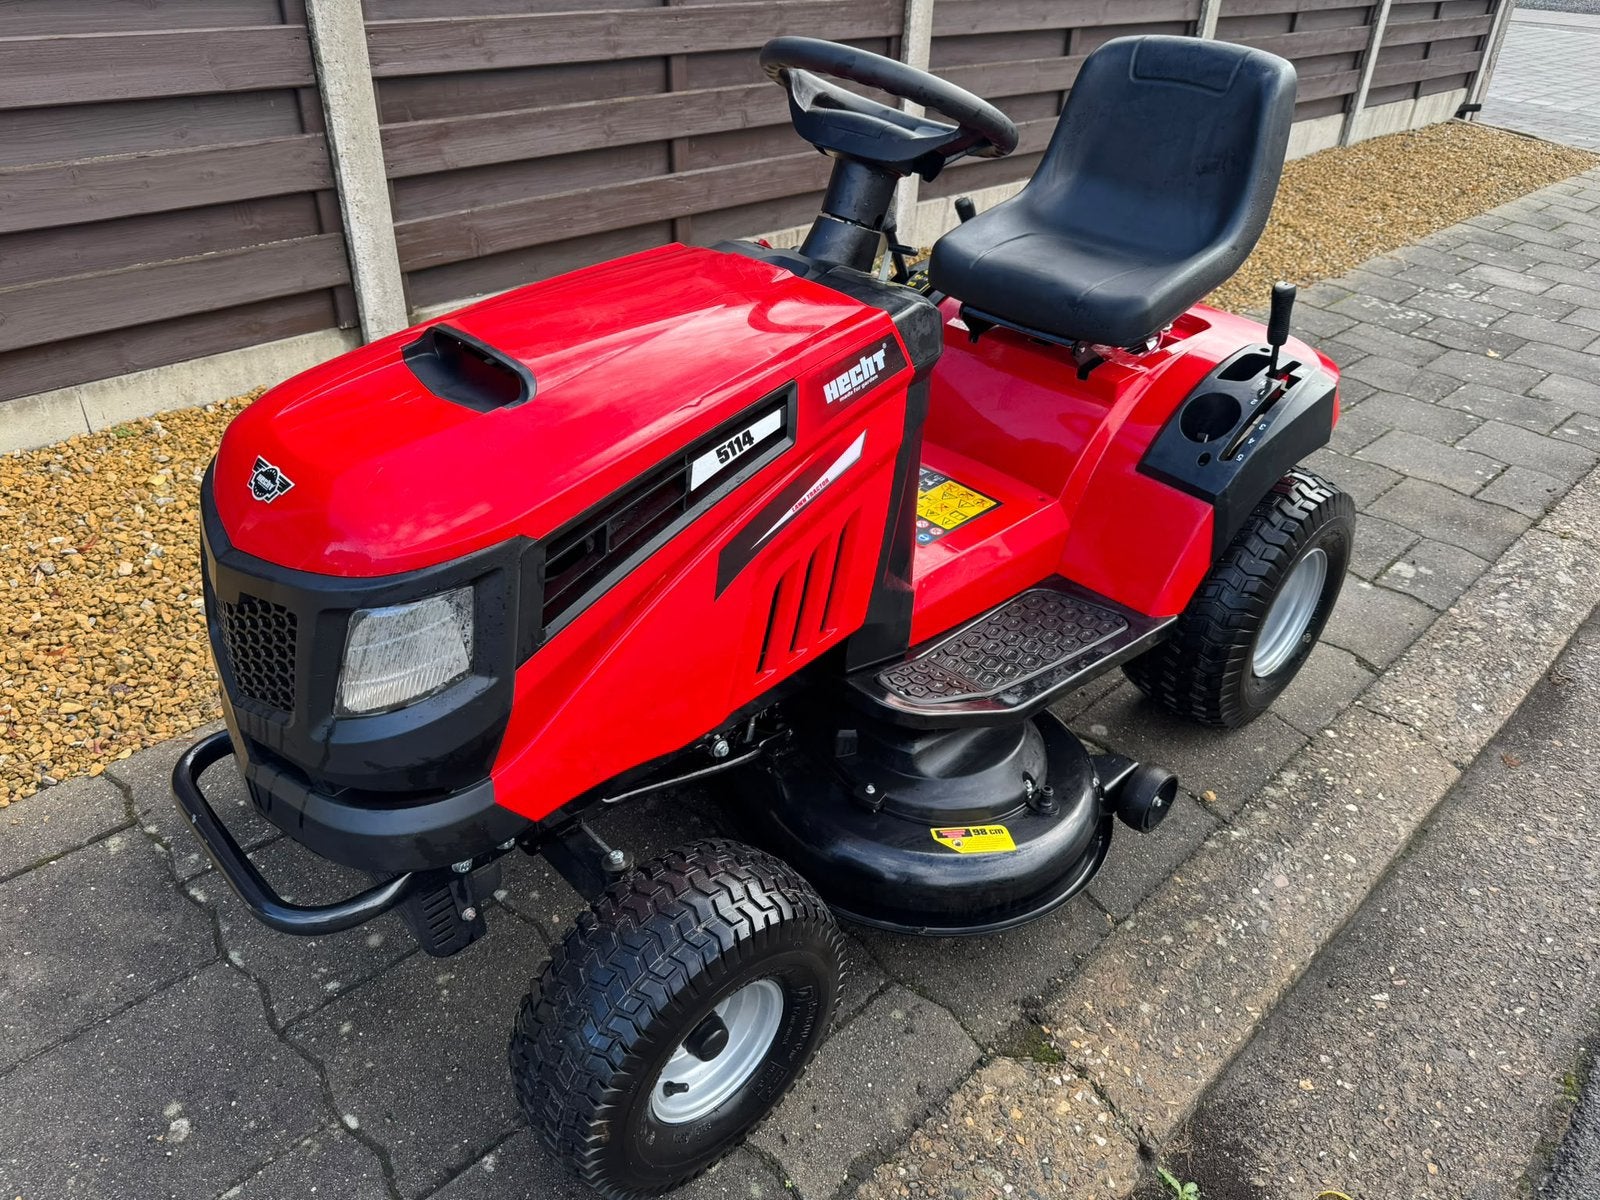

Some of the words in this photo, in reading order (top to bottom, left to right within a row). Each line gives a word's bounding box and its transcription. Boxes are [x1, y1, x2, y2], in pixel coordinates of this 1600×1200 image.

[716, 430, 755, 464] 5114
[791, 496, 807, 513] LAWN
[806, 477, 830, 500] TRACTOR
[972, 828, 988, 836] 98
